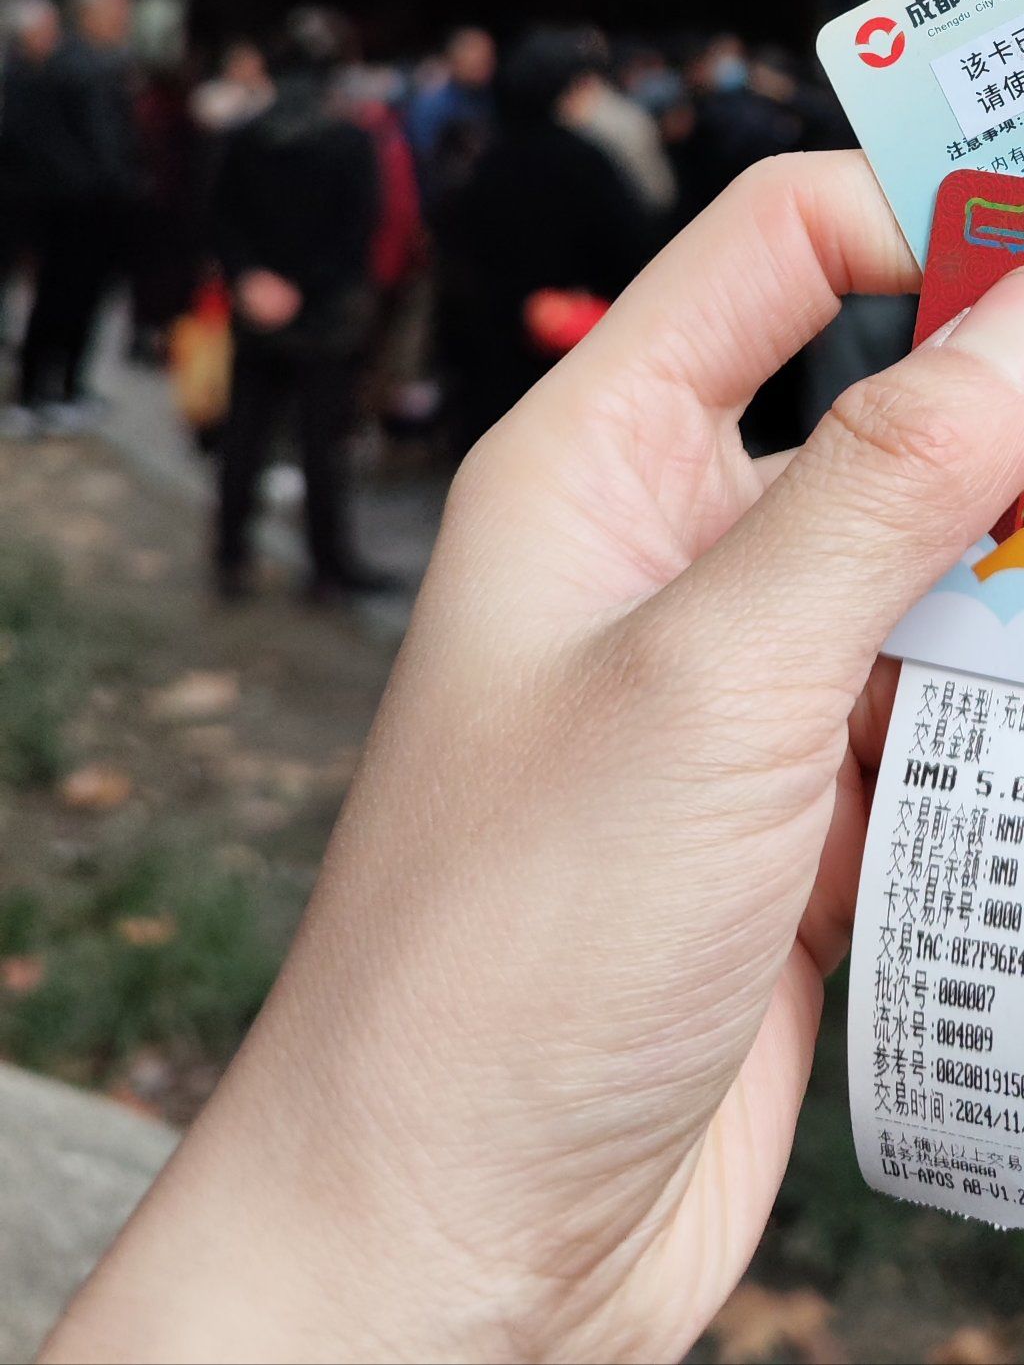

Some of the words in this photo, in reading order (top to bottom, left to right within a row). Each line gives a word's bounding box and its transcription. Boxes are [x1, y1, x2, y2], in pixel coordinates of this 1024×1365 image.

[927, 9, 971, 37] Chengdu
[975, 0, 994, 13] City
[908, 716, 992, 764] 交易金额:
[903, 758, 957, 792] RMB
[878, 1128, 1023, 1172] 本人确认以上交易
[882, 1159, 955, 1190] LDI-APOS
